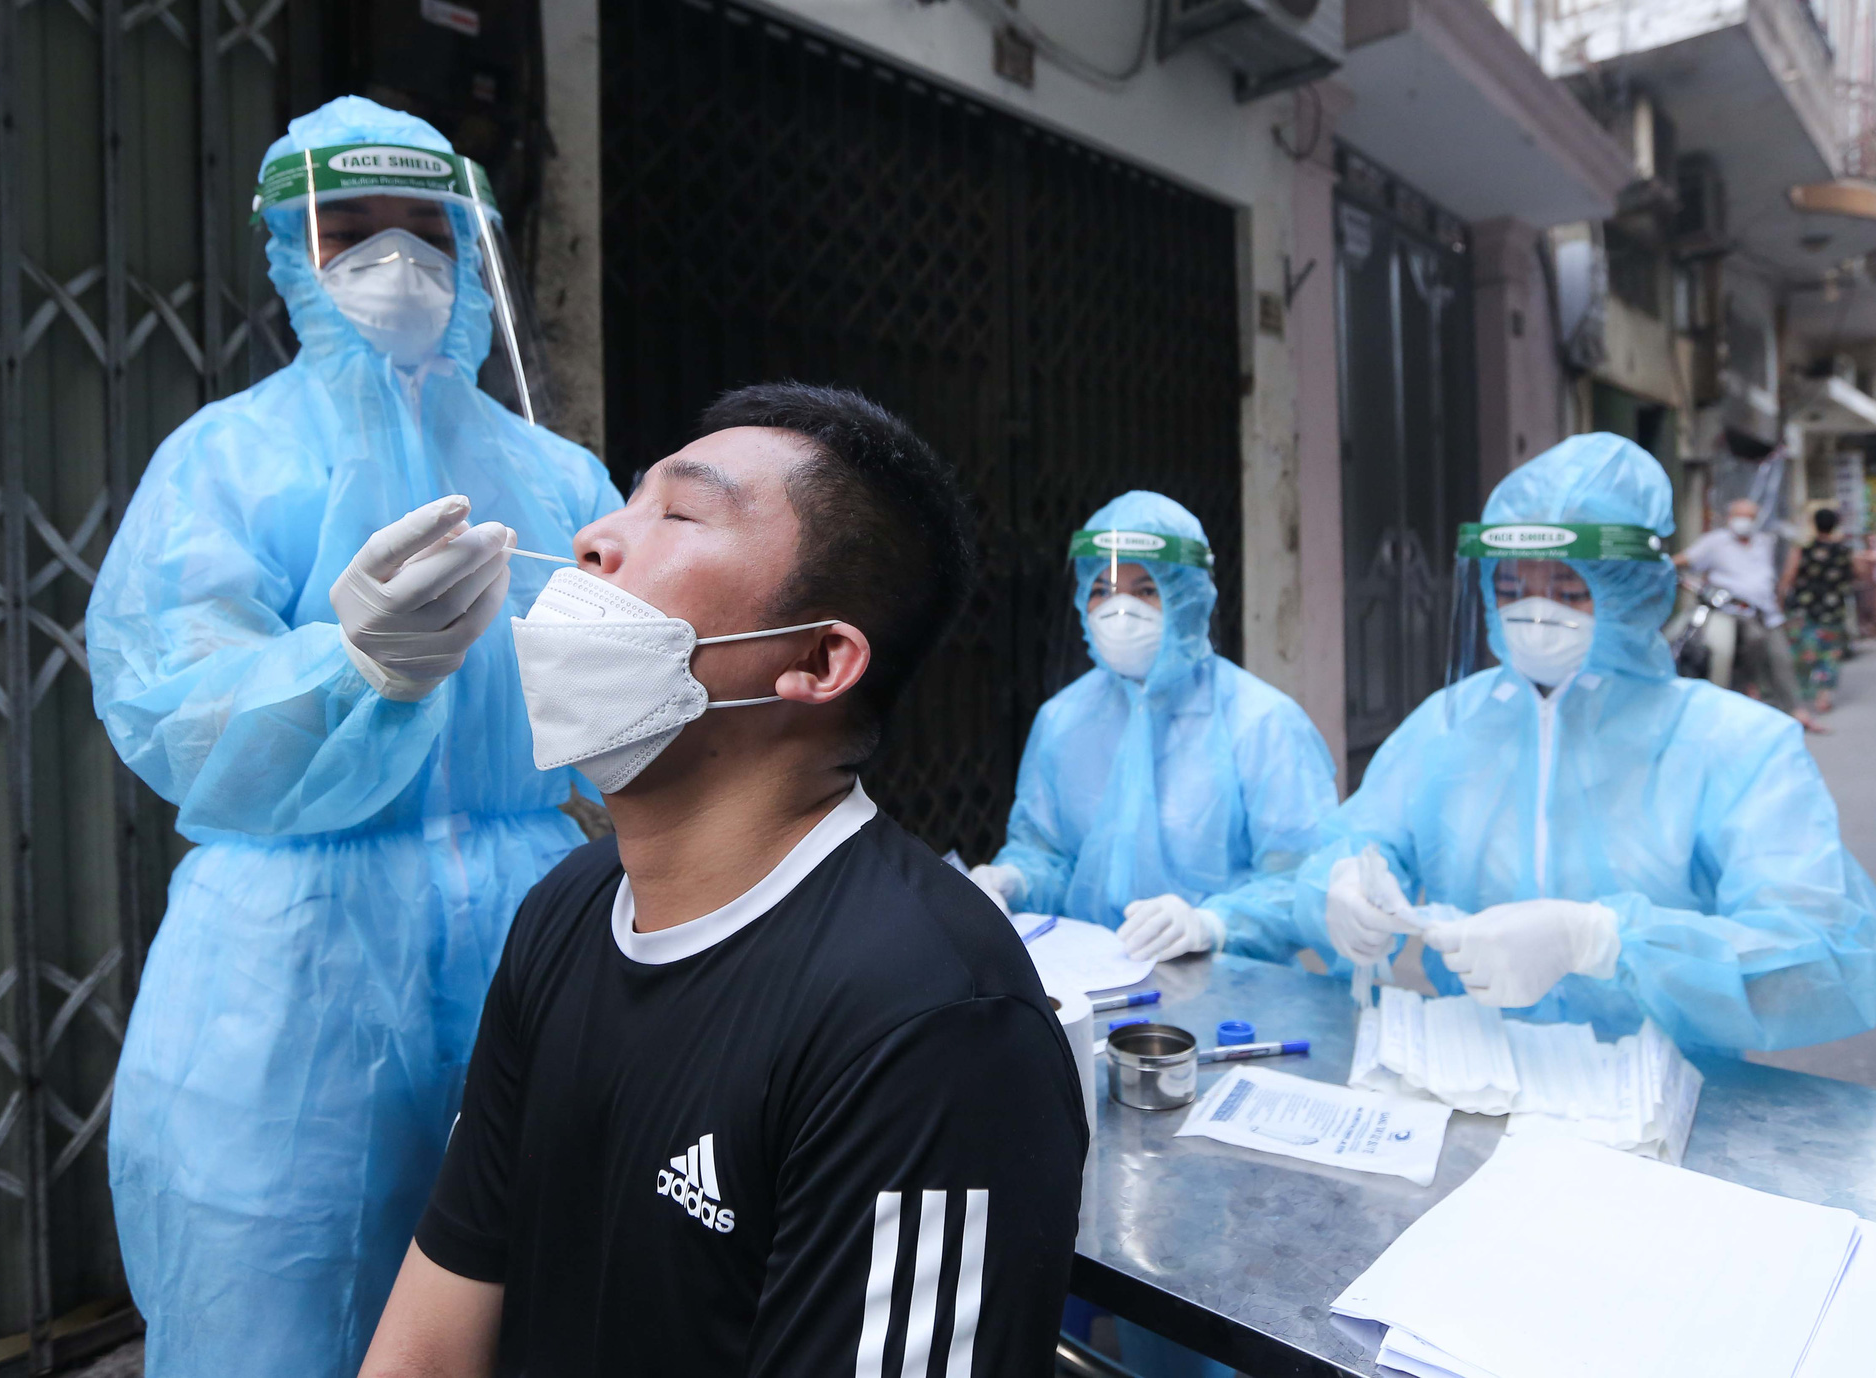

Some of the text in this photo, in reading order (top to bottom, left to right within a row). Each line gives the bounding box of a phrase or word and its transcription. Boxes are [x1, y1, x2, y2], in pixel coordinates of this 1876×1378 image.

[341, 154, 442, 173] FACE SHIELD
[656, 1168, 736, 1234] adidas
